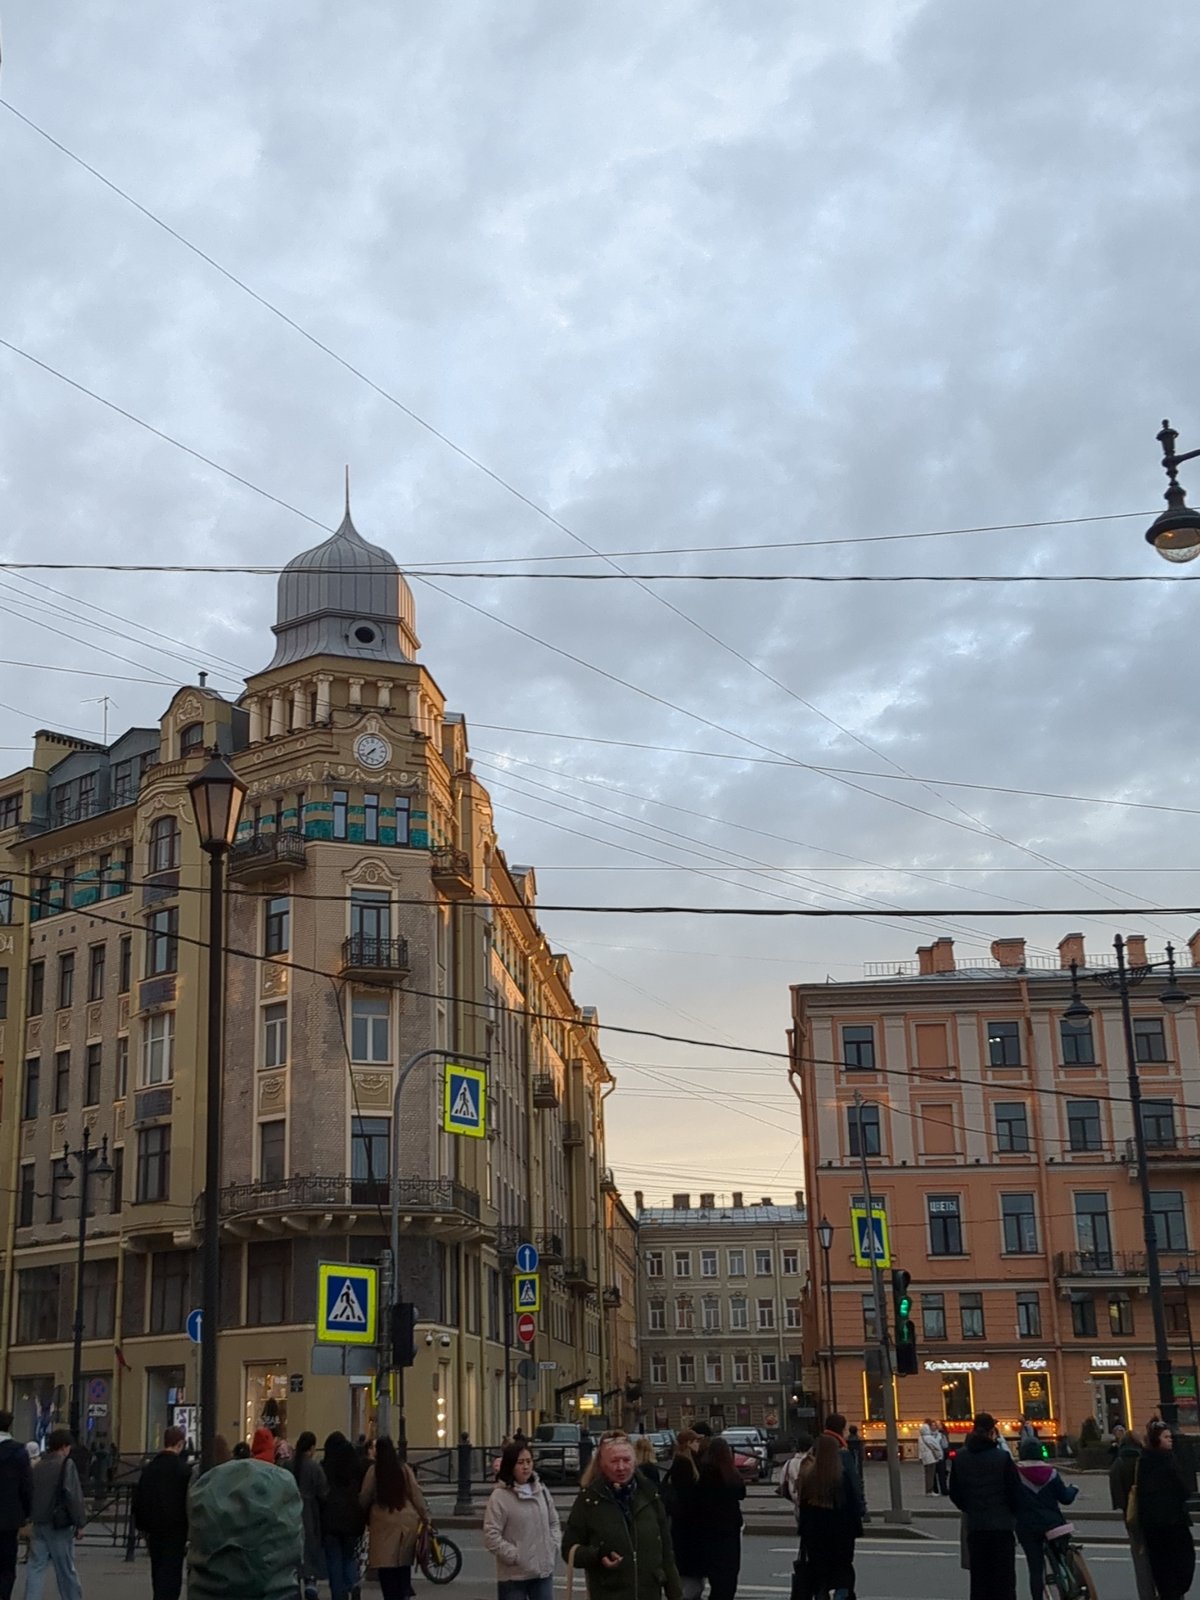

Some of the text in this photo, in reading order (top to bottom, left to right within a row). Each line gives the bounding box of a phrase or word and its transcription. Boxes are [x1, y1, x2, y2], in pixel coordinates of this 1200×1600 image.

[929, 1201, 957, 1211] ЦВЕТЫ
[924, 1360, 989, 1371] Кондитерская
[1020, 1357, 1047, 1369] Кафе
[1091, 1356, 1127, 1367] FermA
